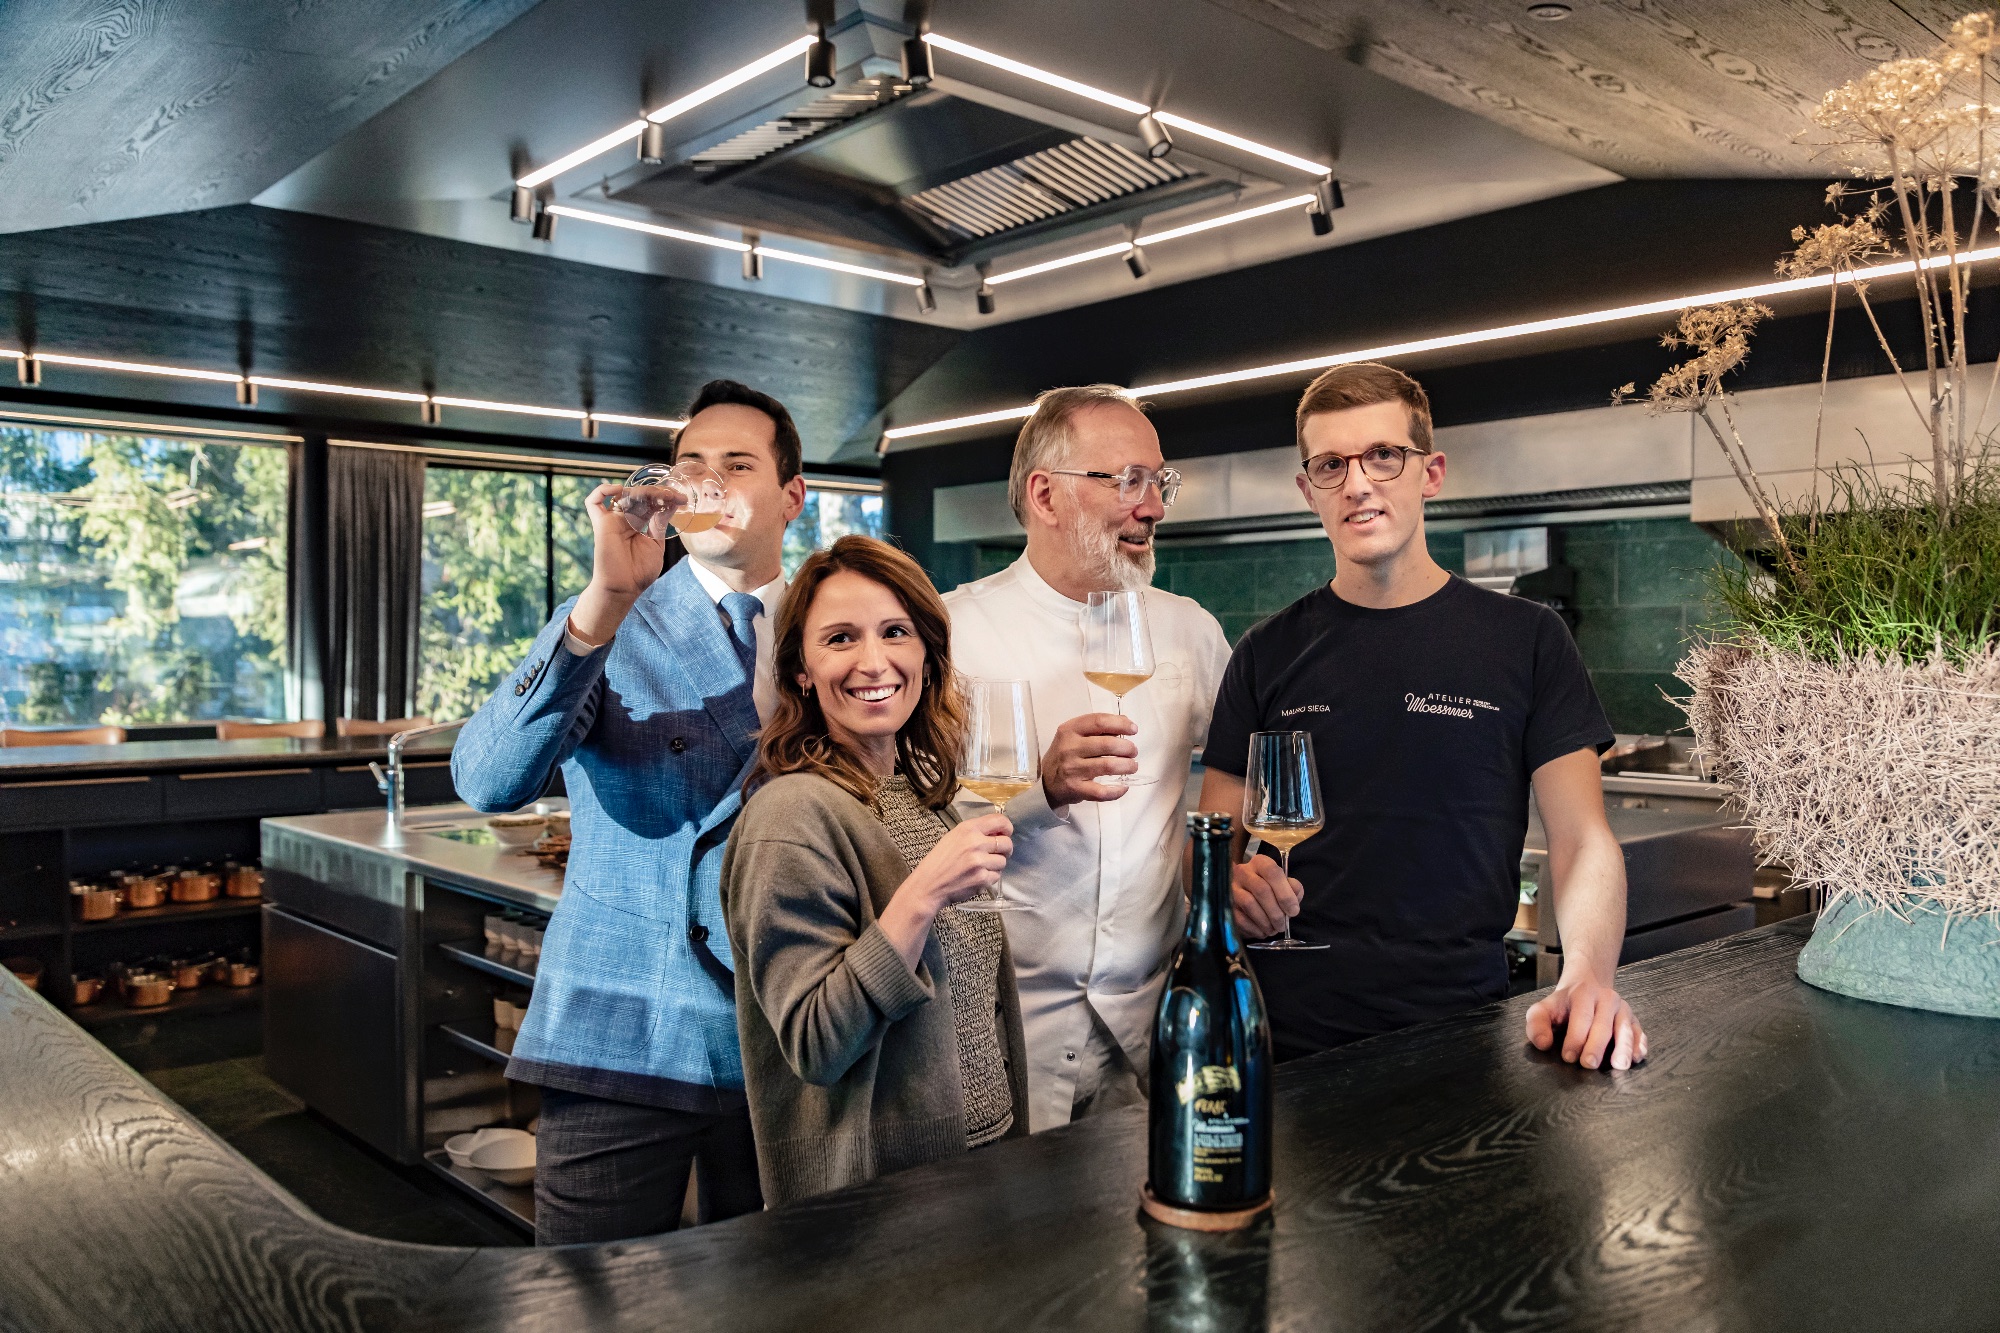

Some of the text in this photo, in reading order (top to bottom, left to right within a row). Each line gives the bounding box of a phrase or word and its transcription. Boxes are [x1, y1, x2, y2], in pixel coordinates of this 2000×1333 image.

[1427, 692, 1472, 705] ATELIER
[1307, 704, 1331, 712] SIEGA
[1404, 692, 1474, 719] Moessmer
